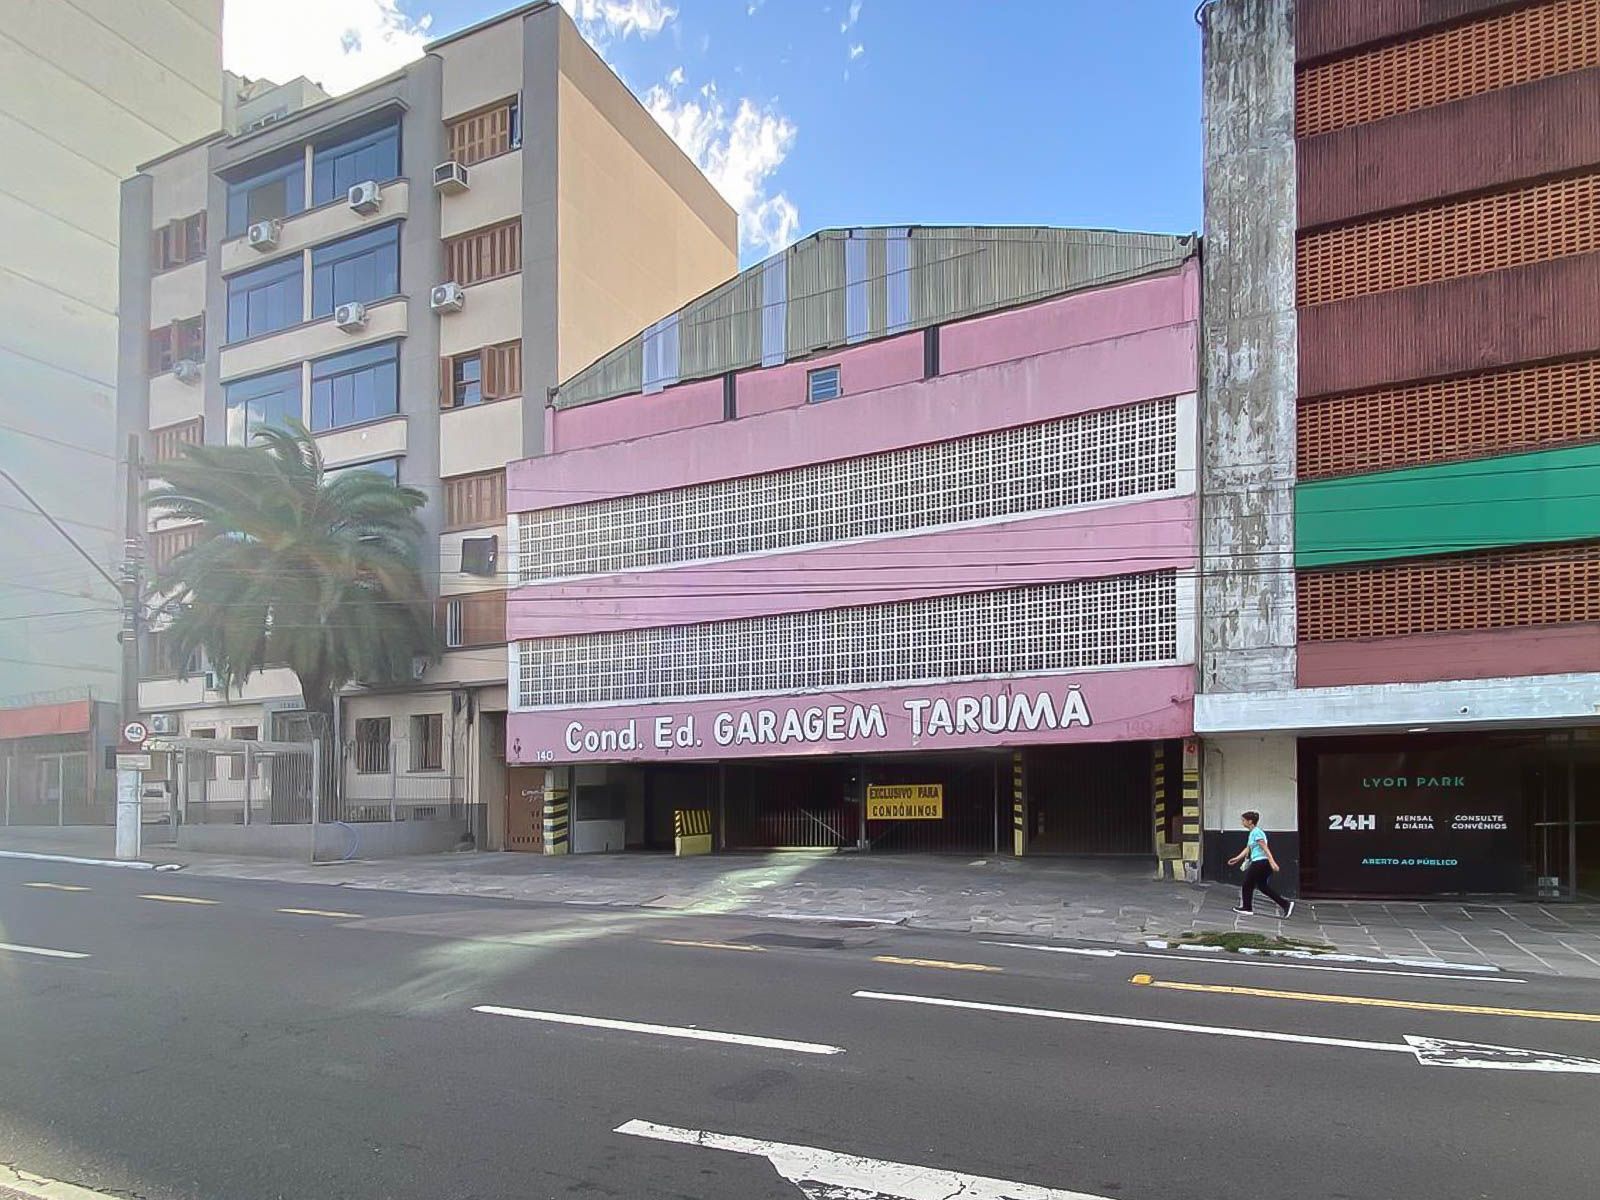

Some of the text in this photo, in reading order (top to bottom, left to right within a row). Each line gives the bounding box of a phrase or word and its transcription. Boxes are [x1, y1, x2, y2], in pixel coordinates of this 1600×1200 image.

[564, 719, 643, 753] Cond.
[655, 715, 703, 749] Ed.
[713, 704, 888, 746] GARAGEM
[903, 684, 1093, 736] TARUMÃ
[127, 726, 142, 736] 40
[536, 750, 554, 761] 140
[1363, 776, 1465, 788] LYON PARK
[870, 786, 939, 799] EXCLUSIVO PARA
[1328, 814, 1376, 831] 24H
[1454, 814, 1504, 822] CONSULTE
[1402, 822, 1435, 830] DIÁRIA
[1451, 821, 1508, 830] CONVÊNIOS
[1401, 858, 1415, 866] AO
